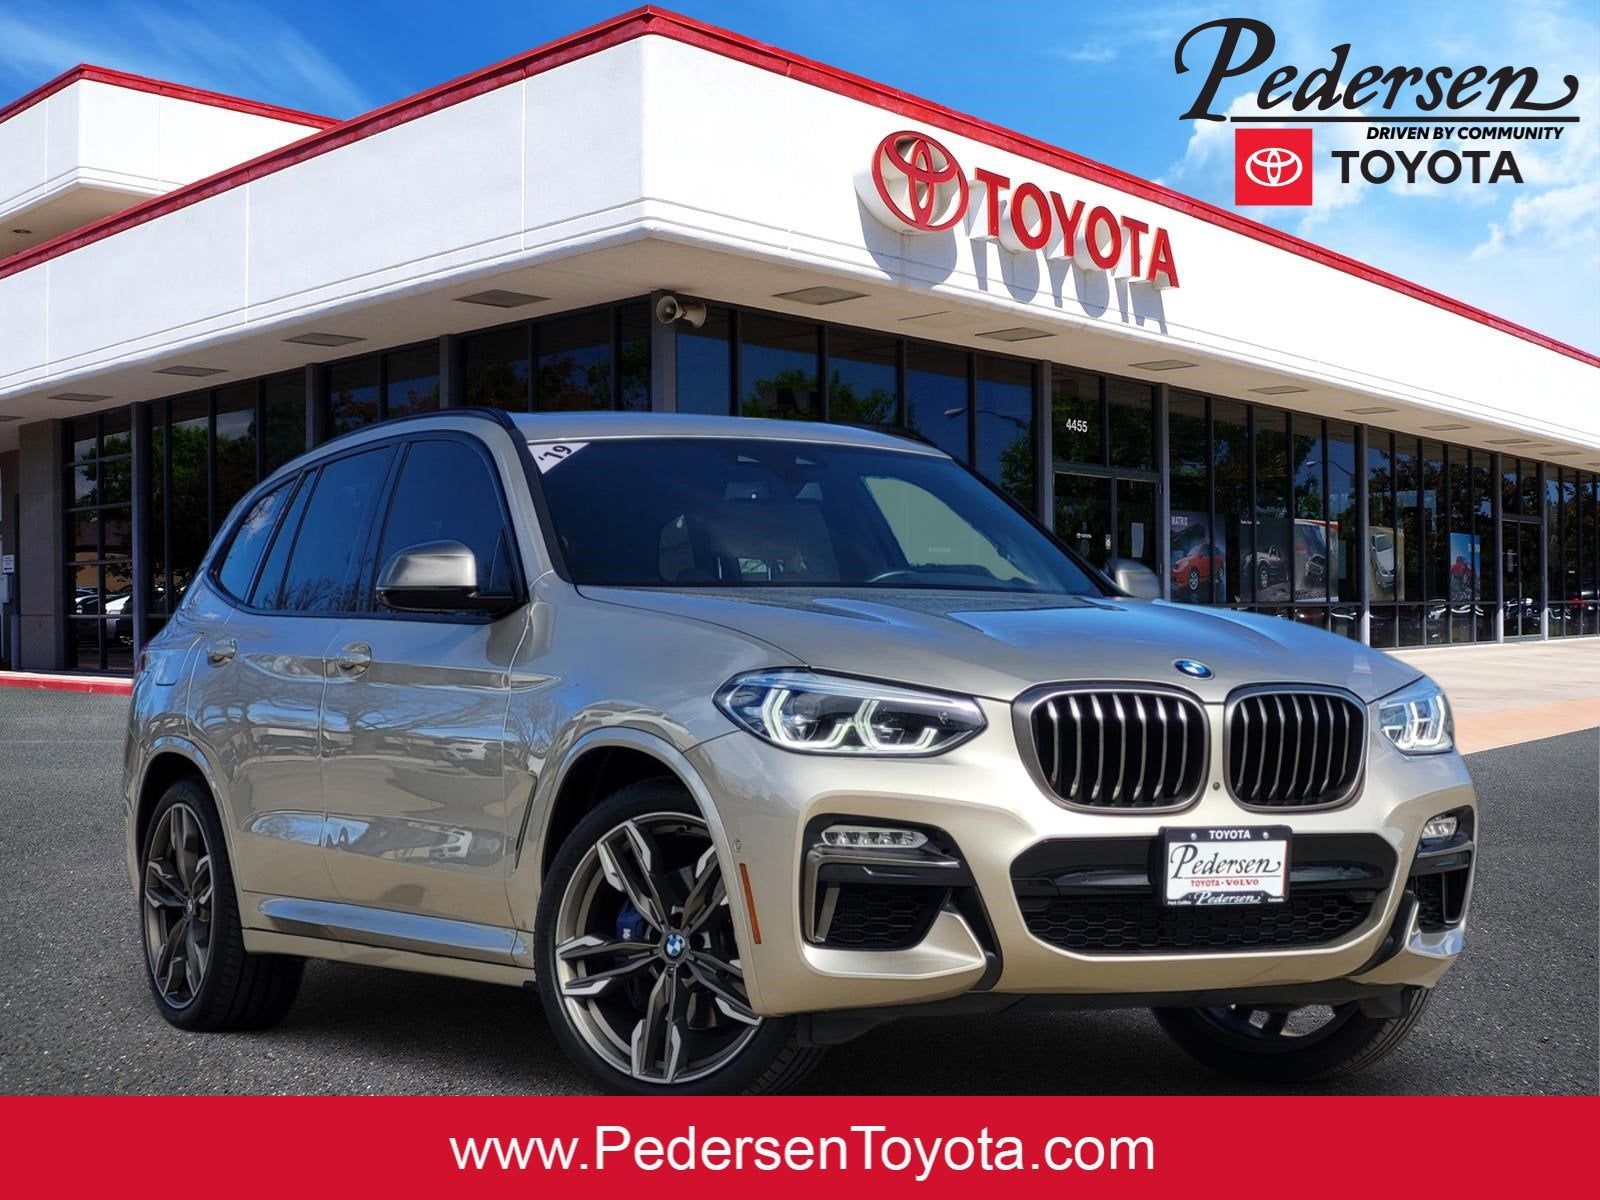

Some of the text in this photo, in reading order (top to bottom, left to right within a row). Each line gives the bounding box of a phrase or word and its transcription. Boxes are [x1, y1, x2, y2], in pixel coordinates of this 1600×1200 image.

[974, 167, 1180, 289] TOYOTA
[1066, 418, 1088, 433] 4455
[1208, 830, 1251, 840] TOYOTA
[1170, 844, 1281, 879] Pedersen
[1194, 891, 1262, 905] Pedersen
